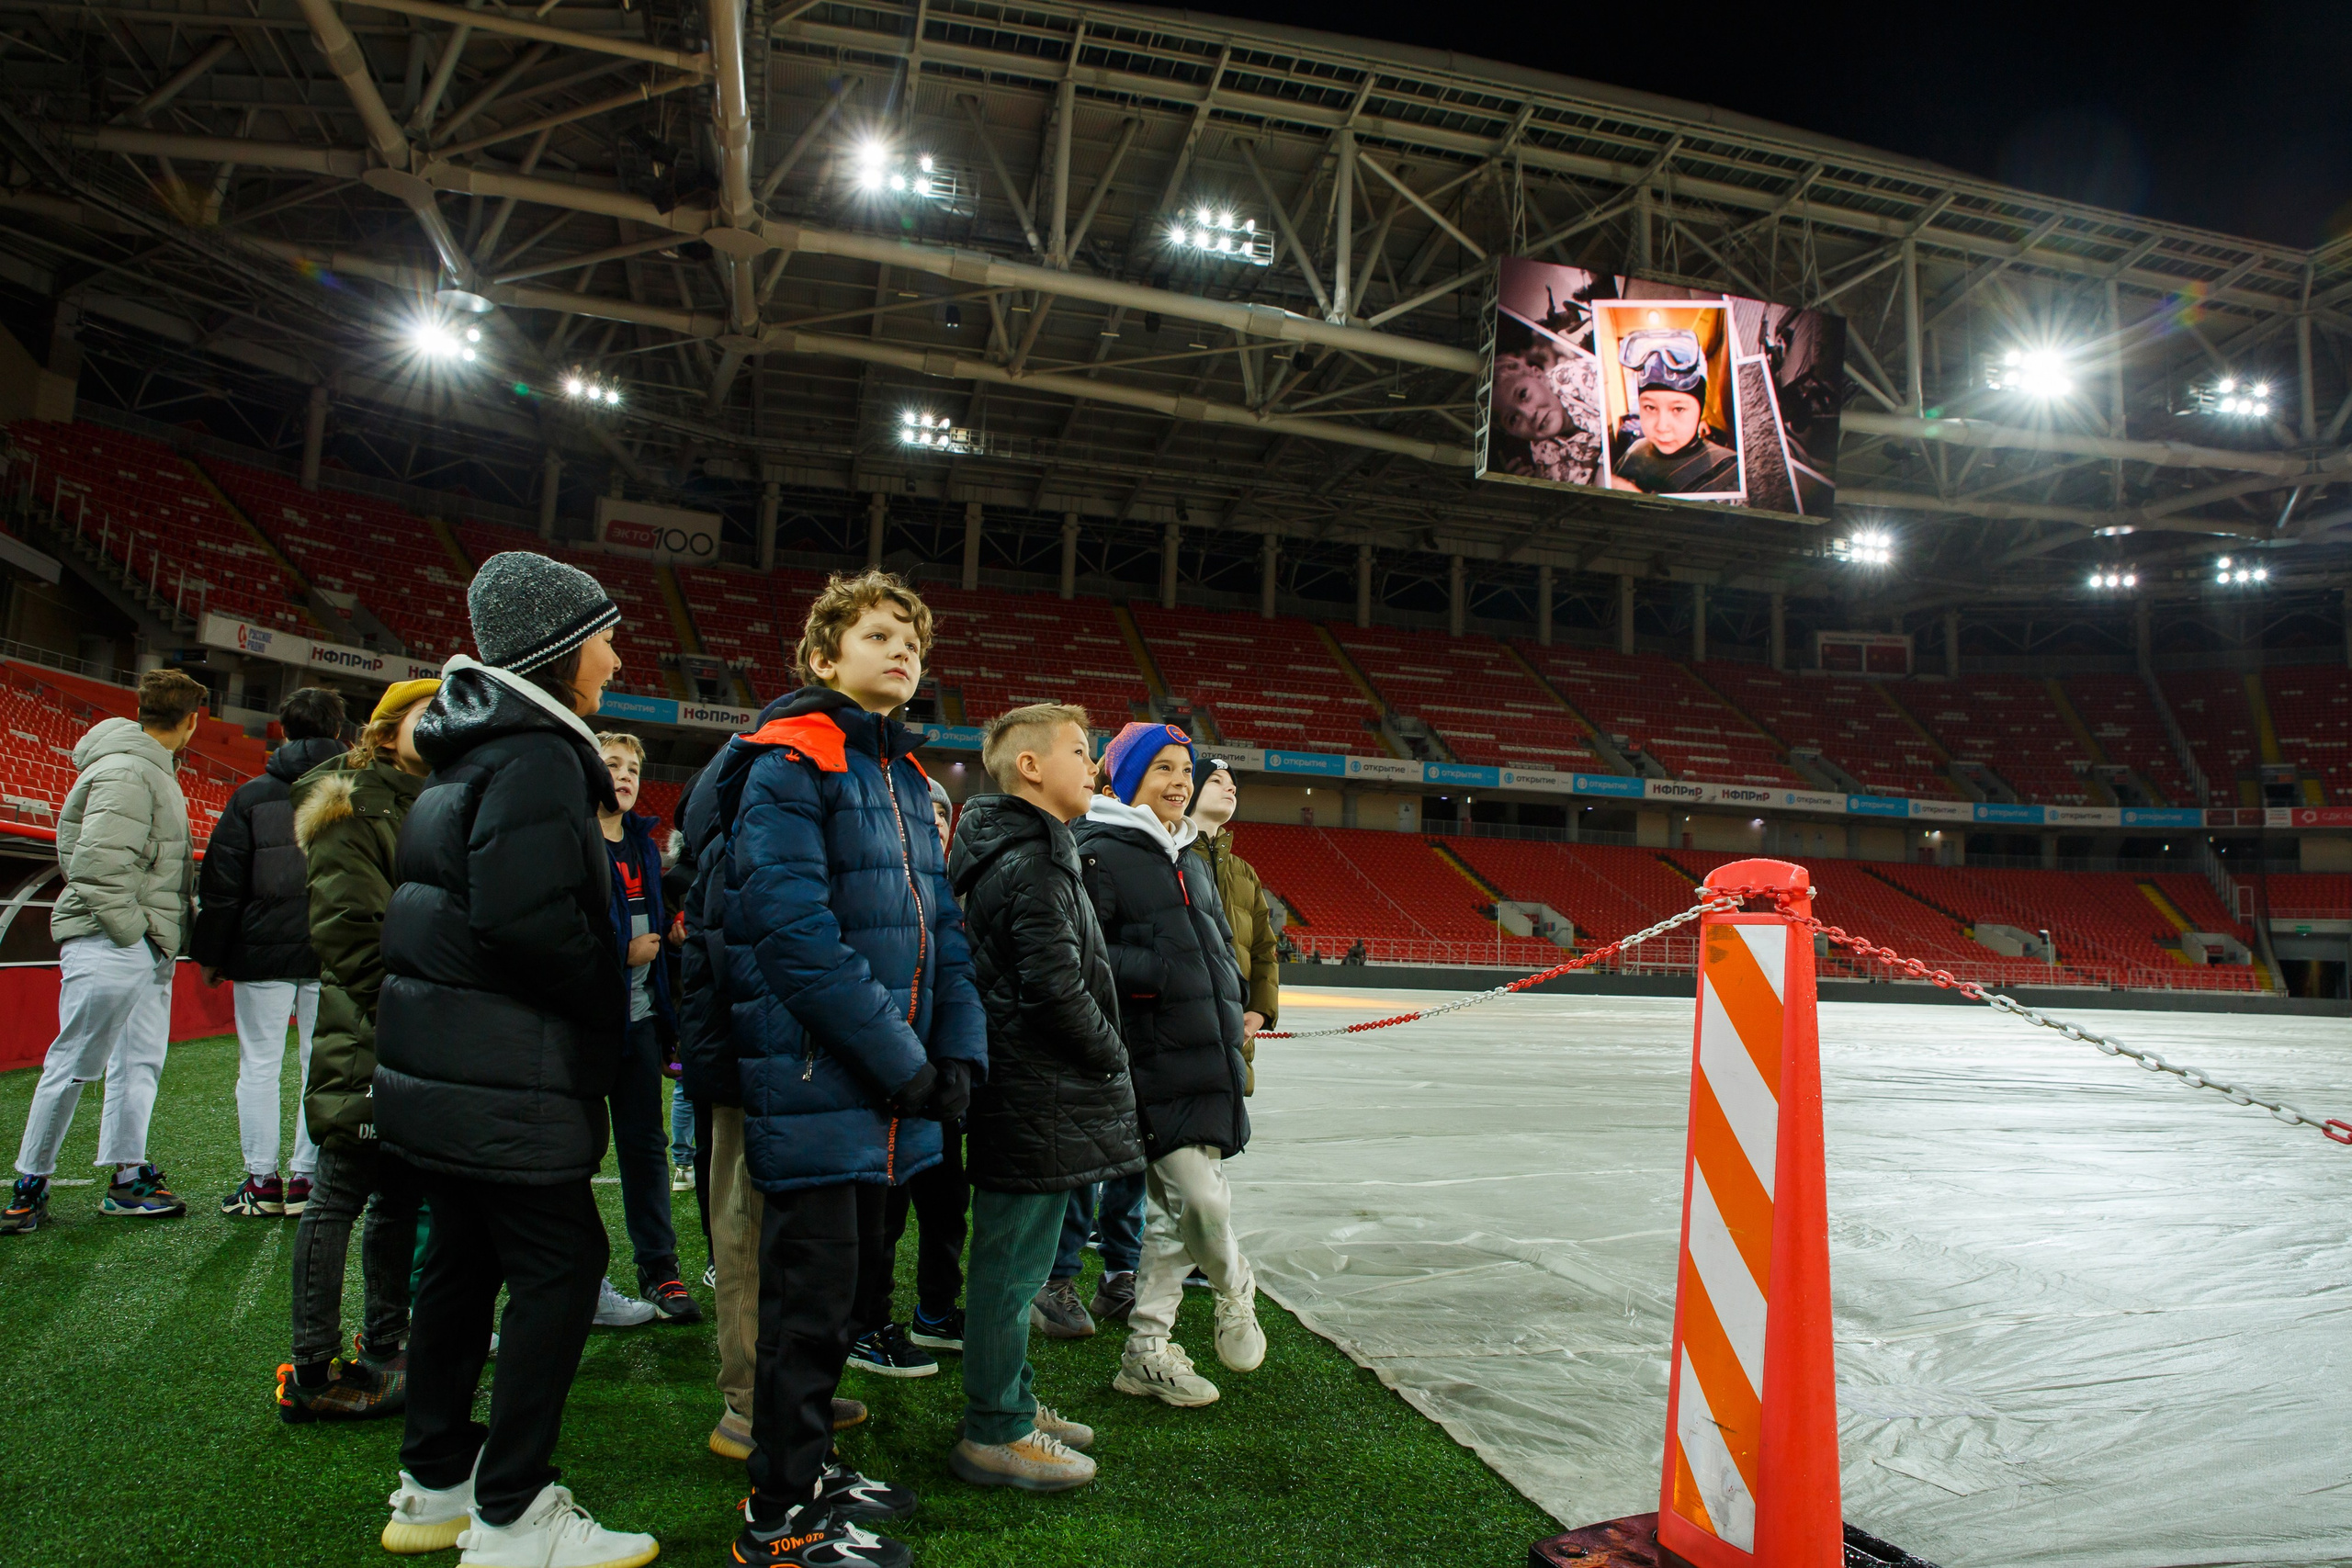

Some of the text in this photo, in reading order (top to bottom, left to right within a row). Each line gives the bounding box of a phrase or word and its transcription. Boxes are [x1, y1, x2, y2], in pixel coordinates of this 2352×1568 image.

[652, 526, 714, 557] 100
[605, 699, 656, 715] открытие
[1283, 757, 1328, 768] открытие
[1363, 763, 1406, 773] открытие
[1441, 769, 1483, 780] открытие
[1516, 774, 1556, 785] открытие
[1589, 780, 1628, 791] открытие
[1796, 795, 1832, 806] открытие
[906, 967, 922, 1026] ALESSANDR
[888, 1116, 899, 1152] ANDRO
